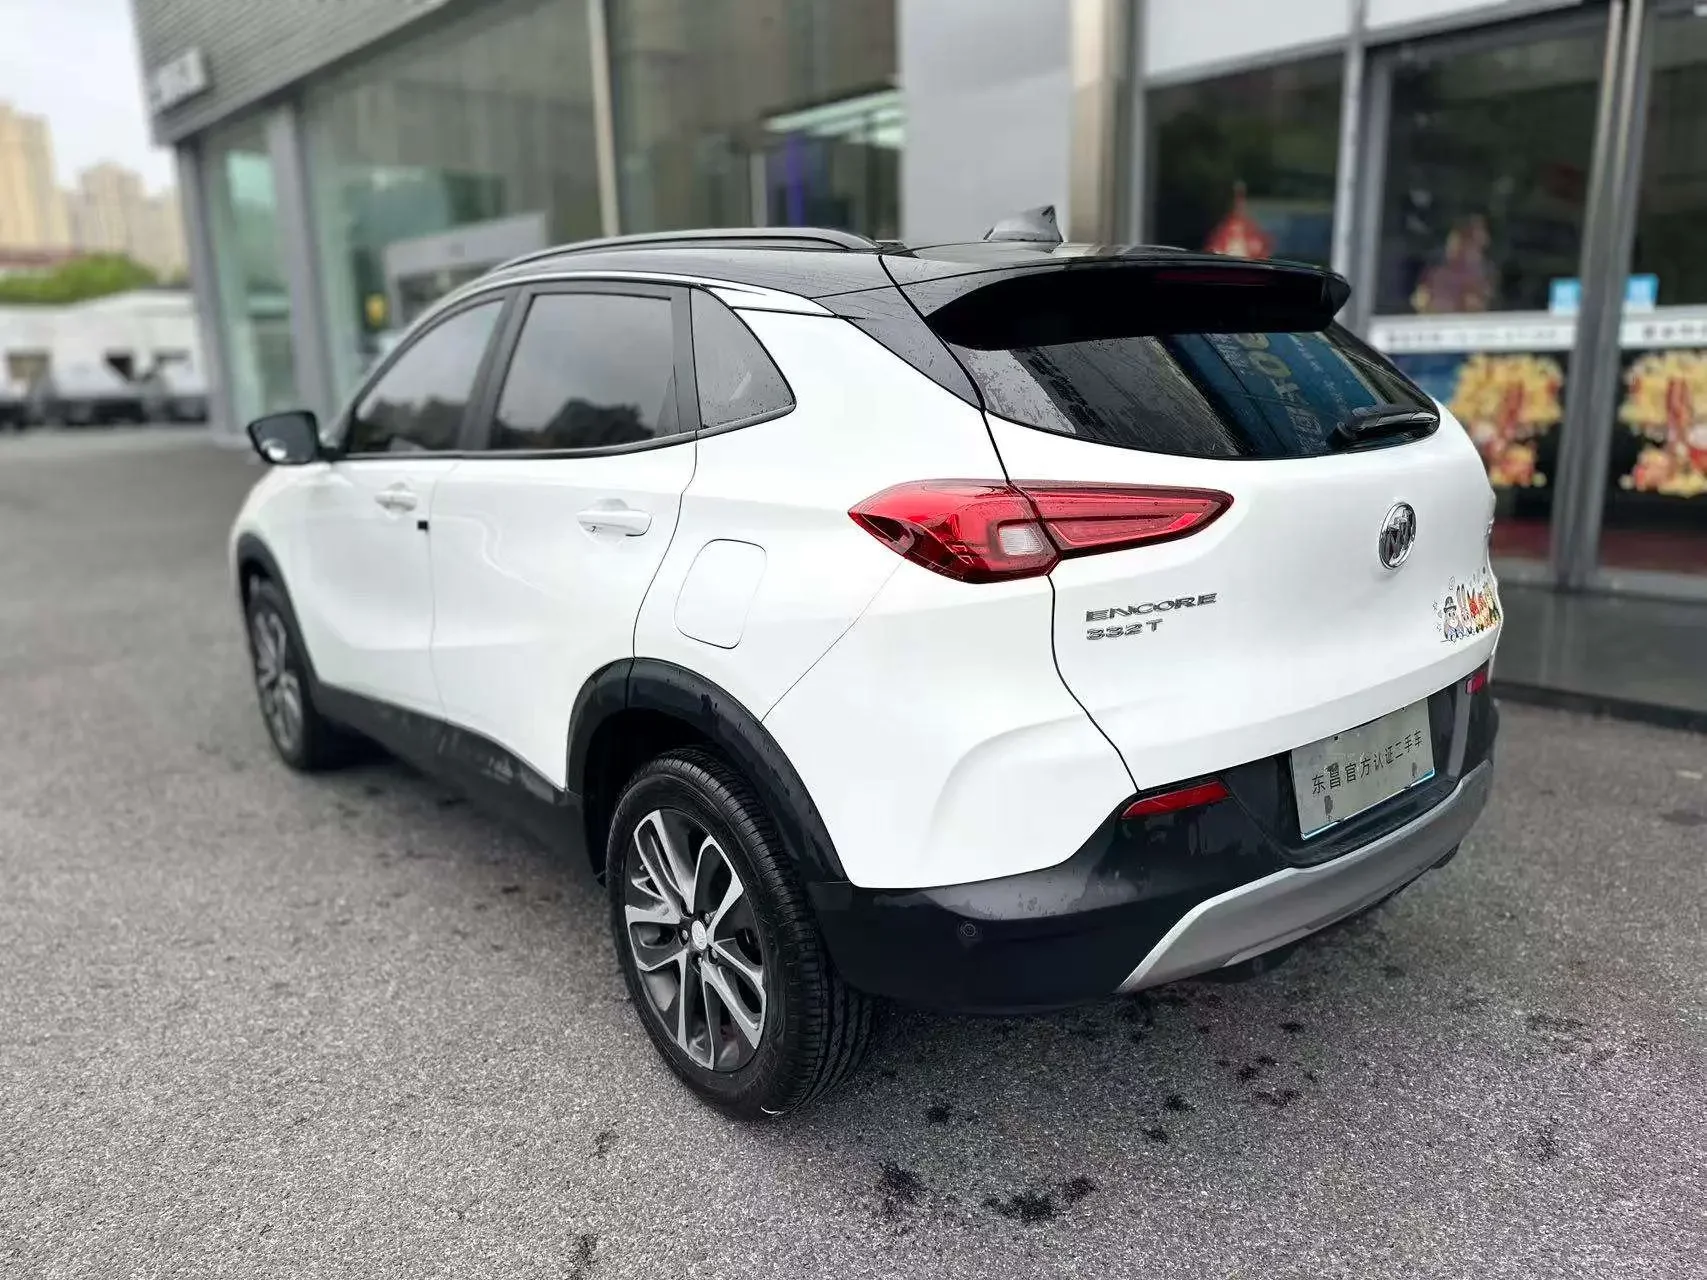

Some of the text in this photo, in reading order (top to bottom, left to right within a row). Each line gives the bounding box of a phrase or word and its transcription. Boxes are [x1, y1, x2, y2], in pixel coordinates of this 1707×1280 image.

[1086, 592, 1218, 622] ENCORE
[1311, 729, 1424, 795] 东昌官方认证二手车
